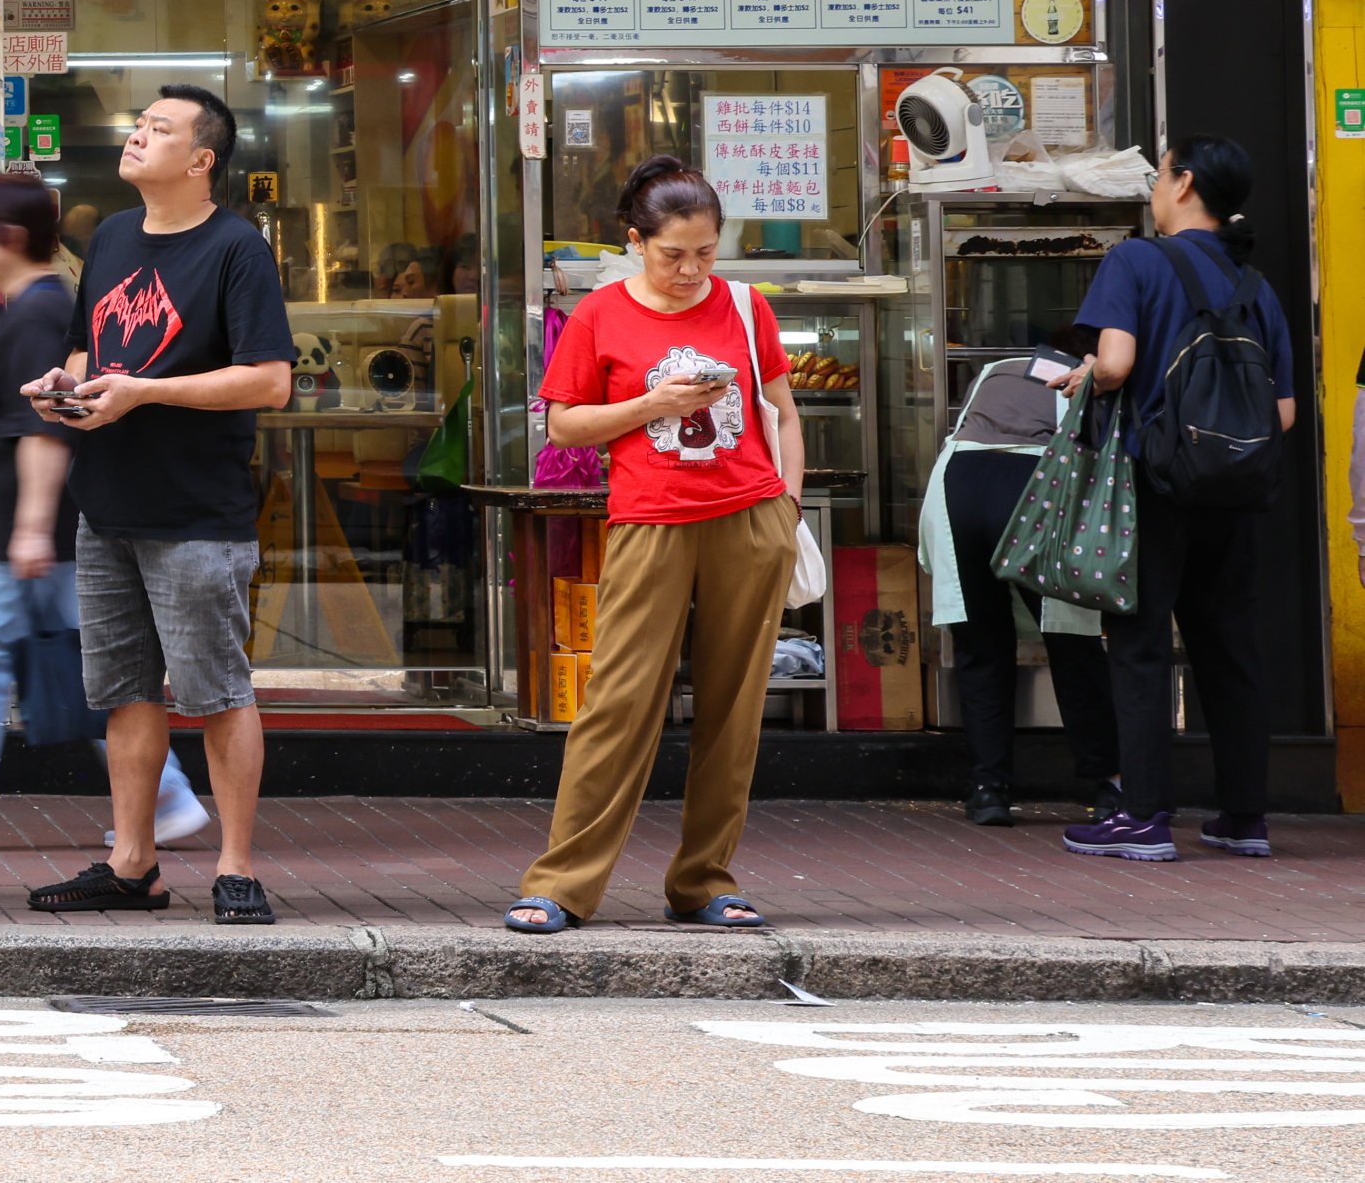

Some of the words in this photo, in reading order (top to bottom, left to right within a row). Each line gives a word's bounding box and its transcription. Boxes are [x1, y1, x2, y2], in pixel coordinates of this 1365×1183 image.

[4, 34, 63, 53] 店廁所
[4, 54, 63, 72] 不外借
[715, 101, 811, 116] 雞批每件$14
[524, 78, 540, 156] 外賣請進
[718, 119, 811, 134] 西餅每件$10
[715, 144, 820, 159] 傳統酥皮蛋撻
[756, 162, 819, 176] 每個$11
[752, 198, 806, 212] 每個$8
